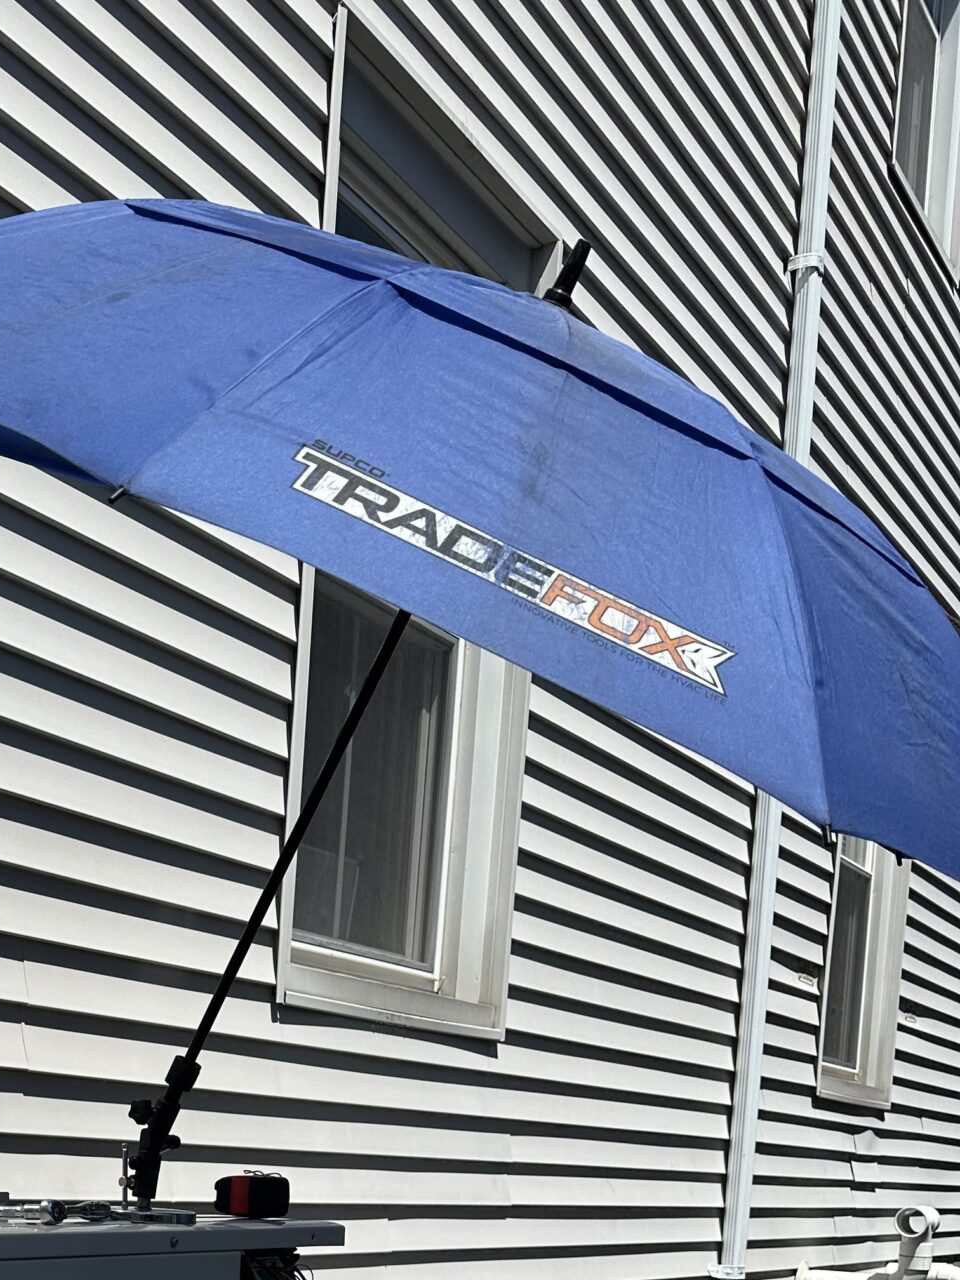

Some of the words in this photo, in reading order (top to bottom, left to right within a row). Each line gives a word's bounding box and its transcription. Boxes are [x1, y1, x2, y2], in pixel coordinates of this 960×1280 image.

[312, 439, 386, 479] SUPCO
[511, 597, 579, 633] INNOVATIVE
[583, 632, 617, 654] TOOLS
[620, 651, 644, 666] FOR
[647, 662, 668, 678] THE
[671, 675, 702, 692] HVAC
[705, 690, 728, 704] LIFE
